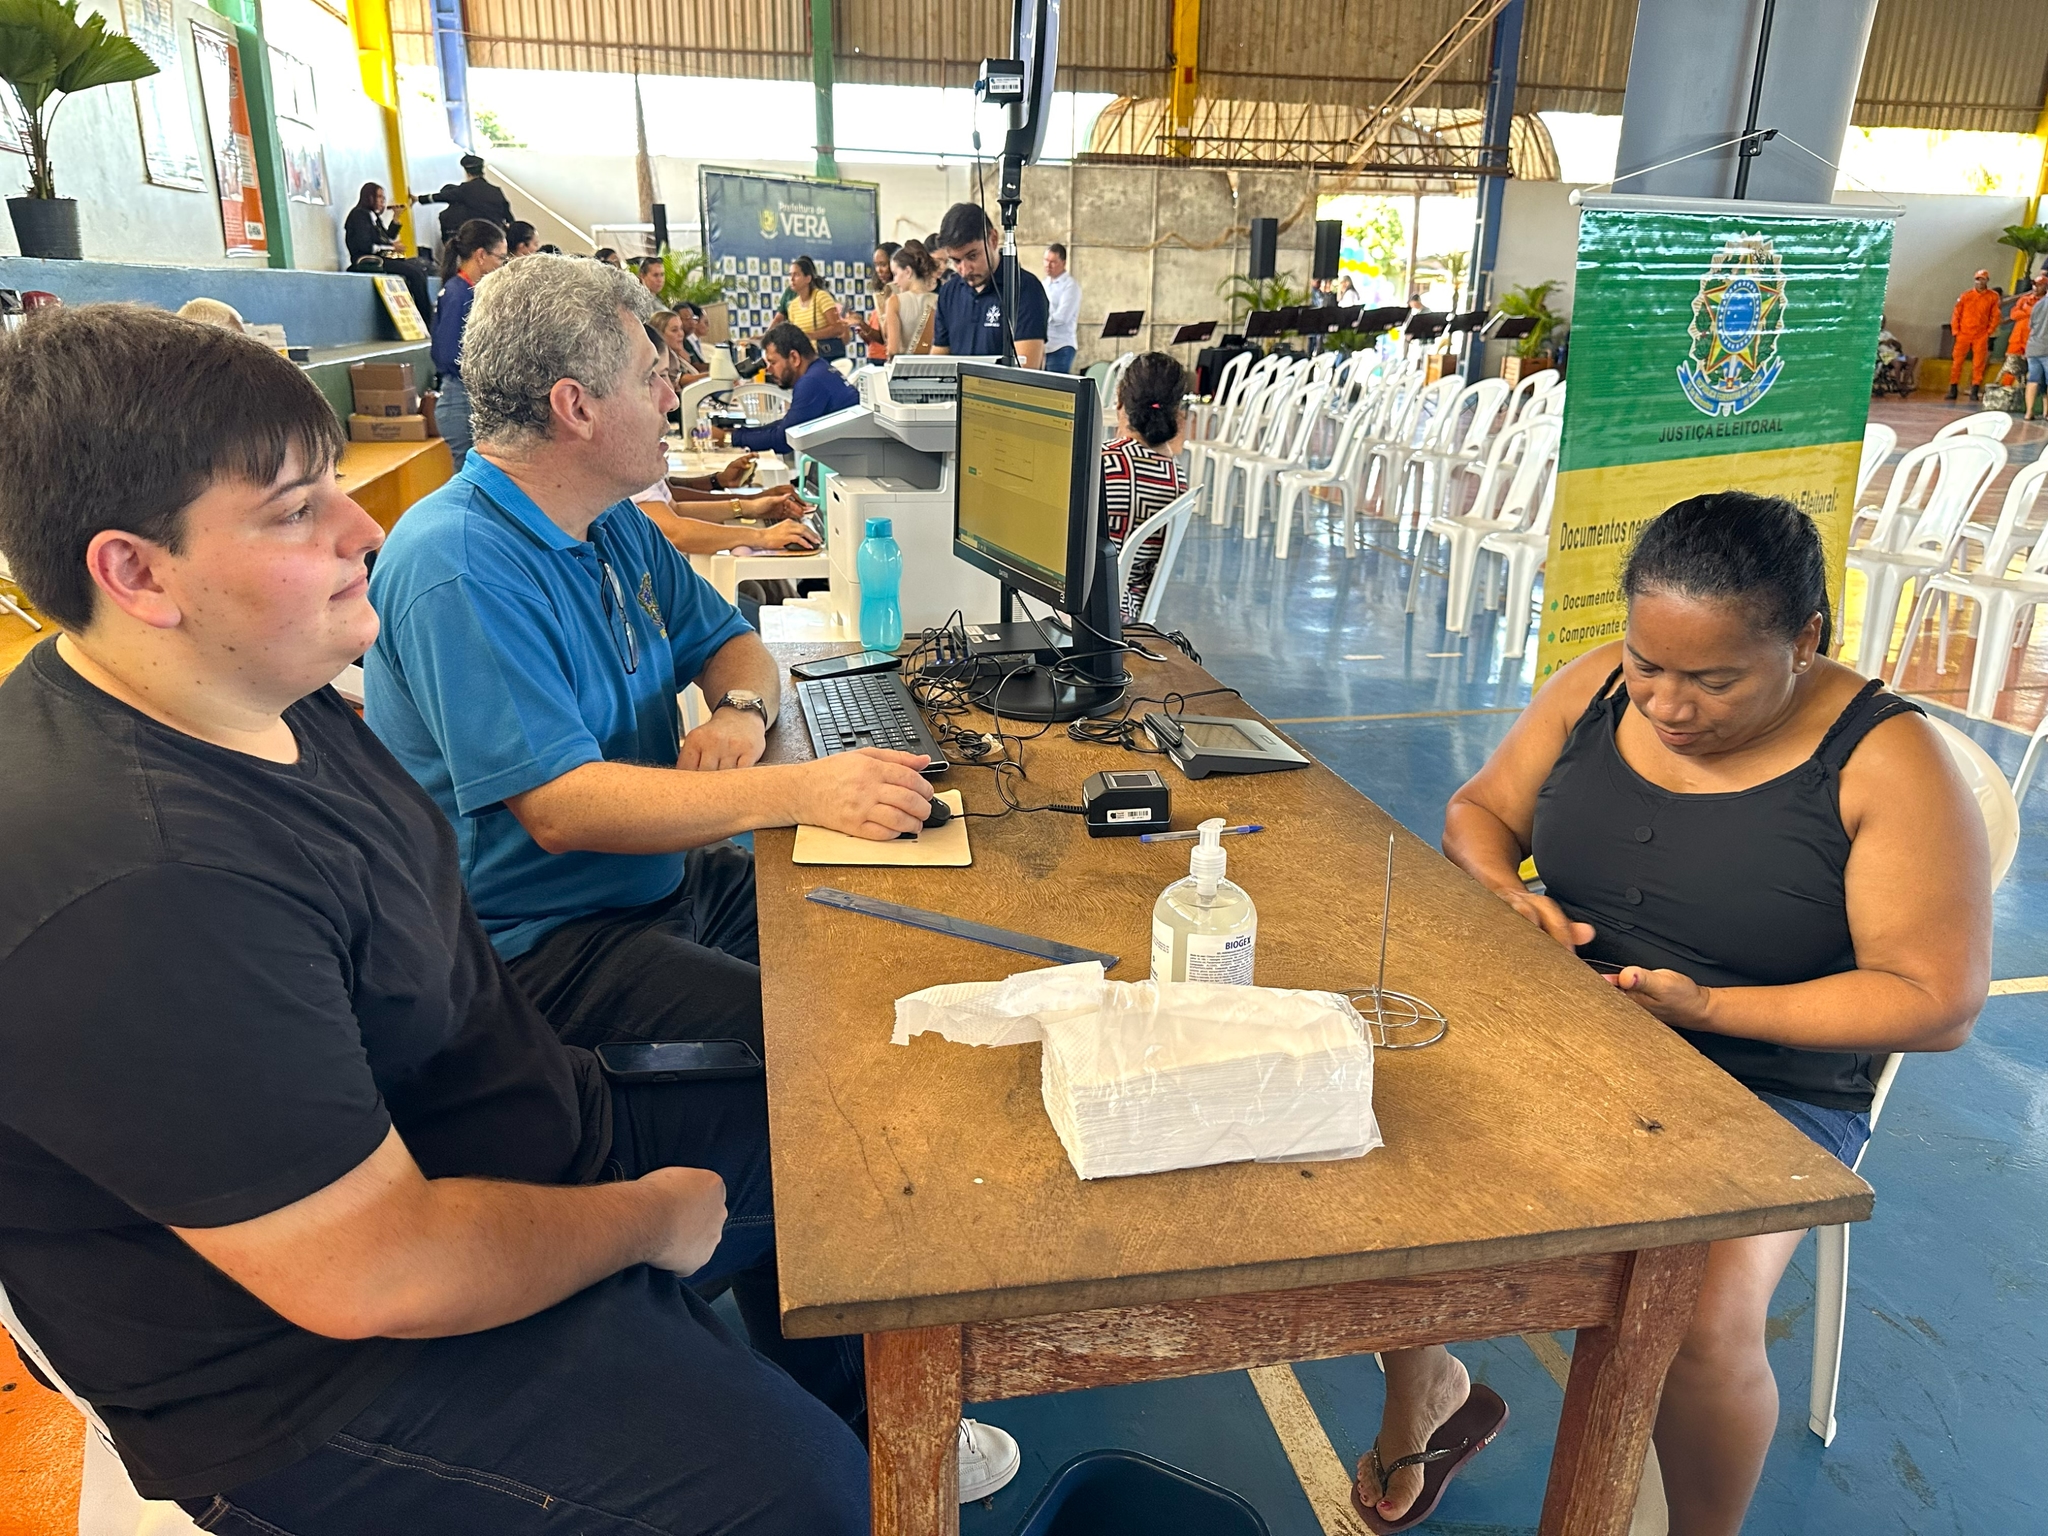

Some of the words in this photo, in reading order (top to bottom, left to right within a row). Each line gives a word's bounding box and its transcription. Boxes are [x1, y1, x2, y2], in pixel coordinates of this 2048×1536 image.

[779, 212, 832, 239] VERA
[1658, 424, 1714, 443] JUSTIÇA
[1715, 418, 1783, 438] ELEITORAL
[1560, 517, 1627, 551] Documentos
[1563, 589, 1615, 611] Documento
[1559, 619, 1620, 643] Comprovante
